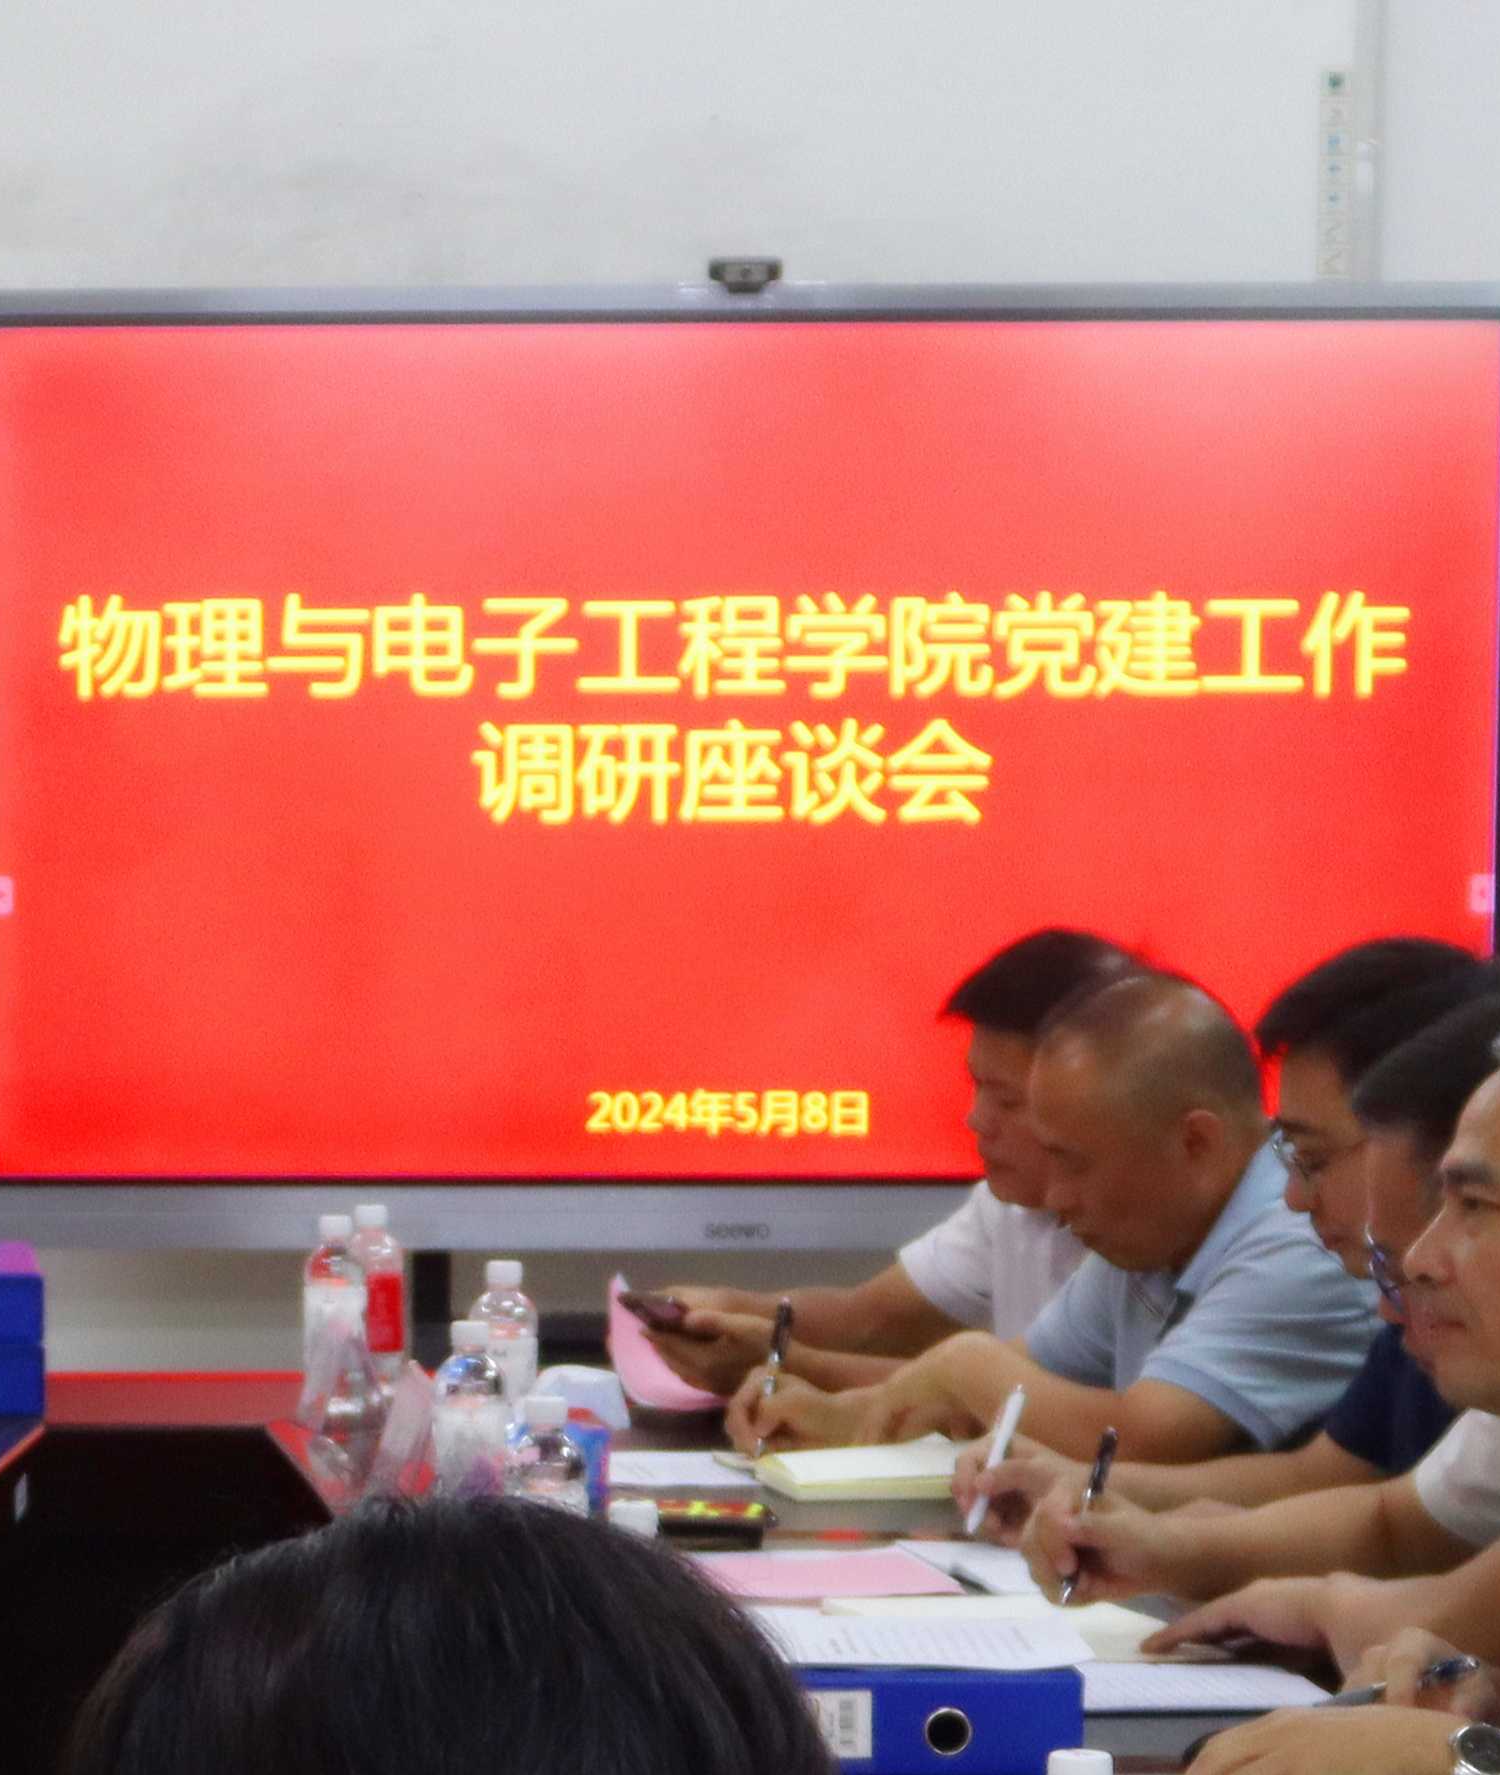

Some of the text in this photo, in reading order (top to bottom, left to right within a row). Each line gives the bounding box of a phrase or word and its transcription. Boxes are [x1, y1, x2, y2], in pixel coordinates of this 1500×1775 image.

[59, 592, 1411, 700] 物理与电子工程学院党建工作
[472, 717, 992, 825] 调研座谈会
[586, 1087, 870, 1138] 2024年5月8日
